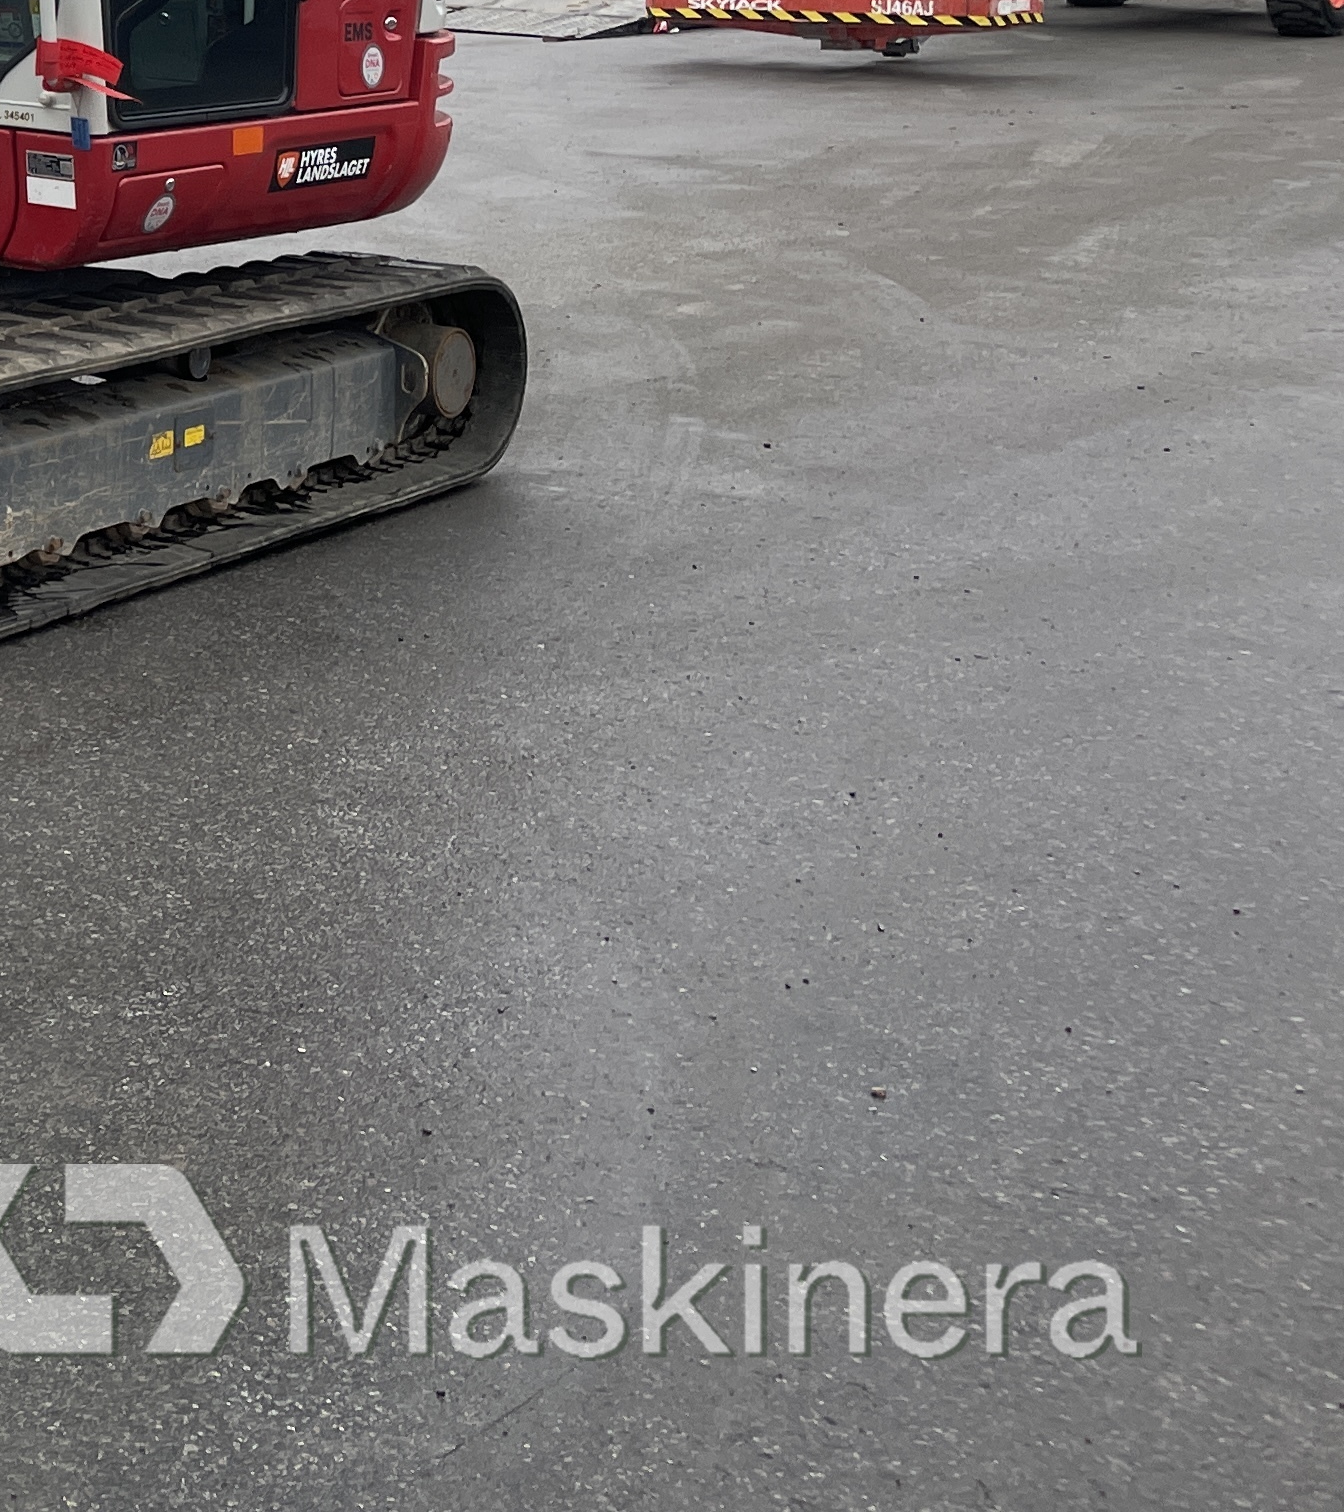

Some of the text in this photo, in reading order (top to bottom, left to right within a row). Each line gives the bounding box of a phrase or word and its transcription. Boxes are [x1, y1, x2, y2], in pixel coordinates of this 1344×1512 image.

[871, 0, 935, 17] SJ46AJ
[344, 22, 373, 42] EMS
[300, 146, 338, 168] HYRES
[295, 158, 370, 184] LANDSLAGET
